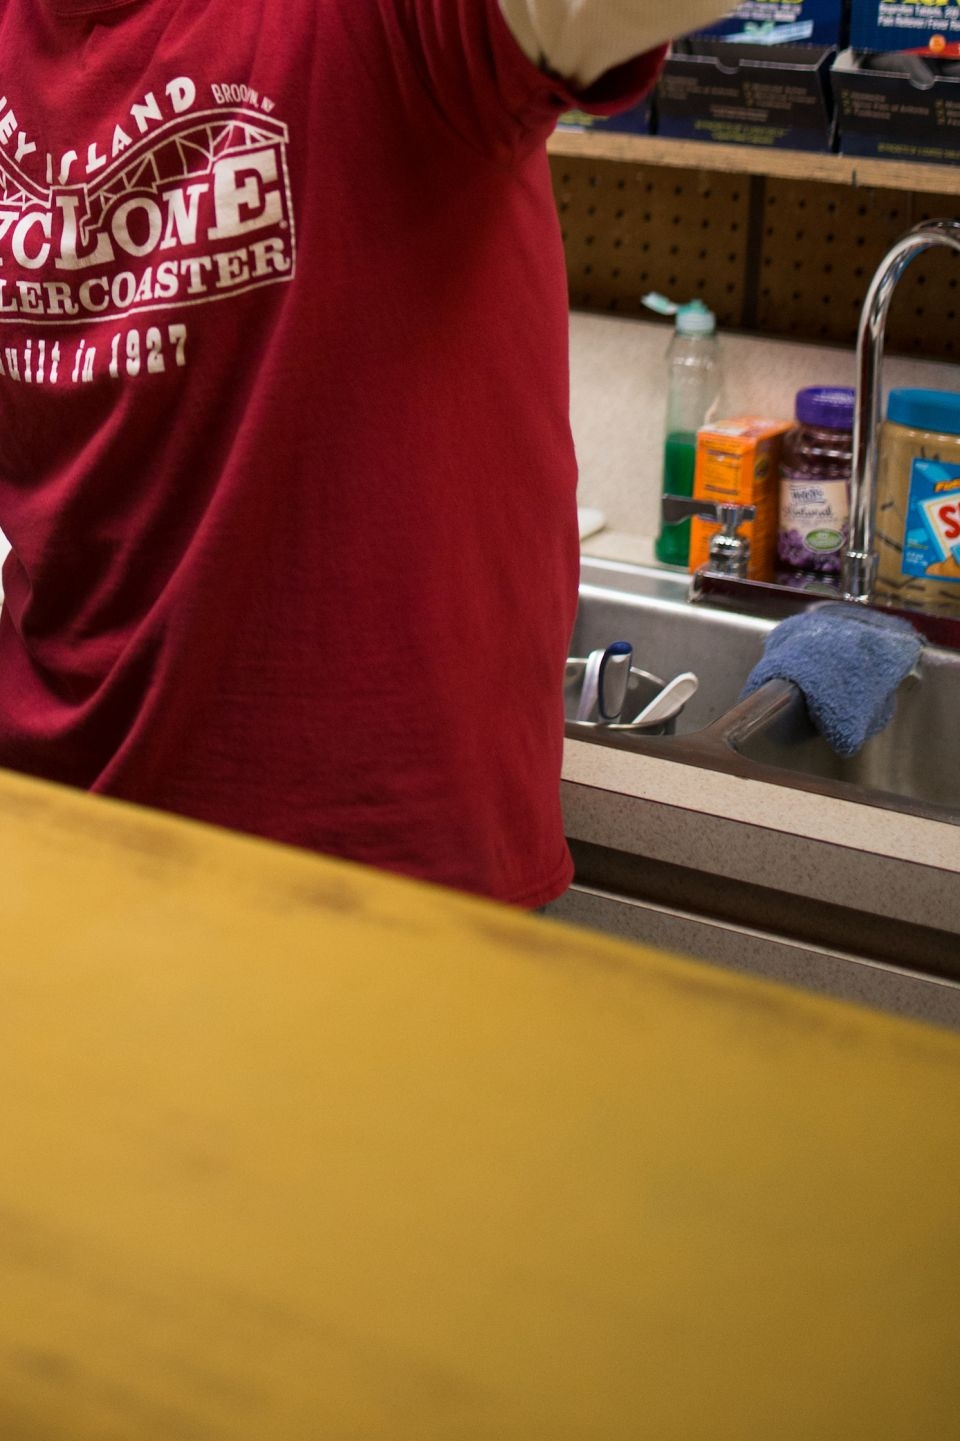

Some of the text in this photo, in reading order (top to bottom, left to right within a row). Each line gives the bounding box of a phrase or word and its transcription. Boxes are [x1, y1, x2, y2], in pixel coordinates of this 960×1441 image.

[45, 76, 197, 185] ISLAND
[71, 338, 98, 384] in
[108, 323, 188, 380] 1927
